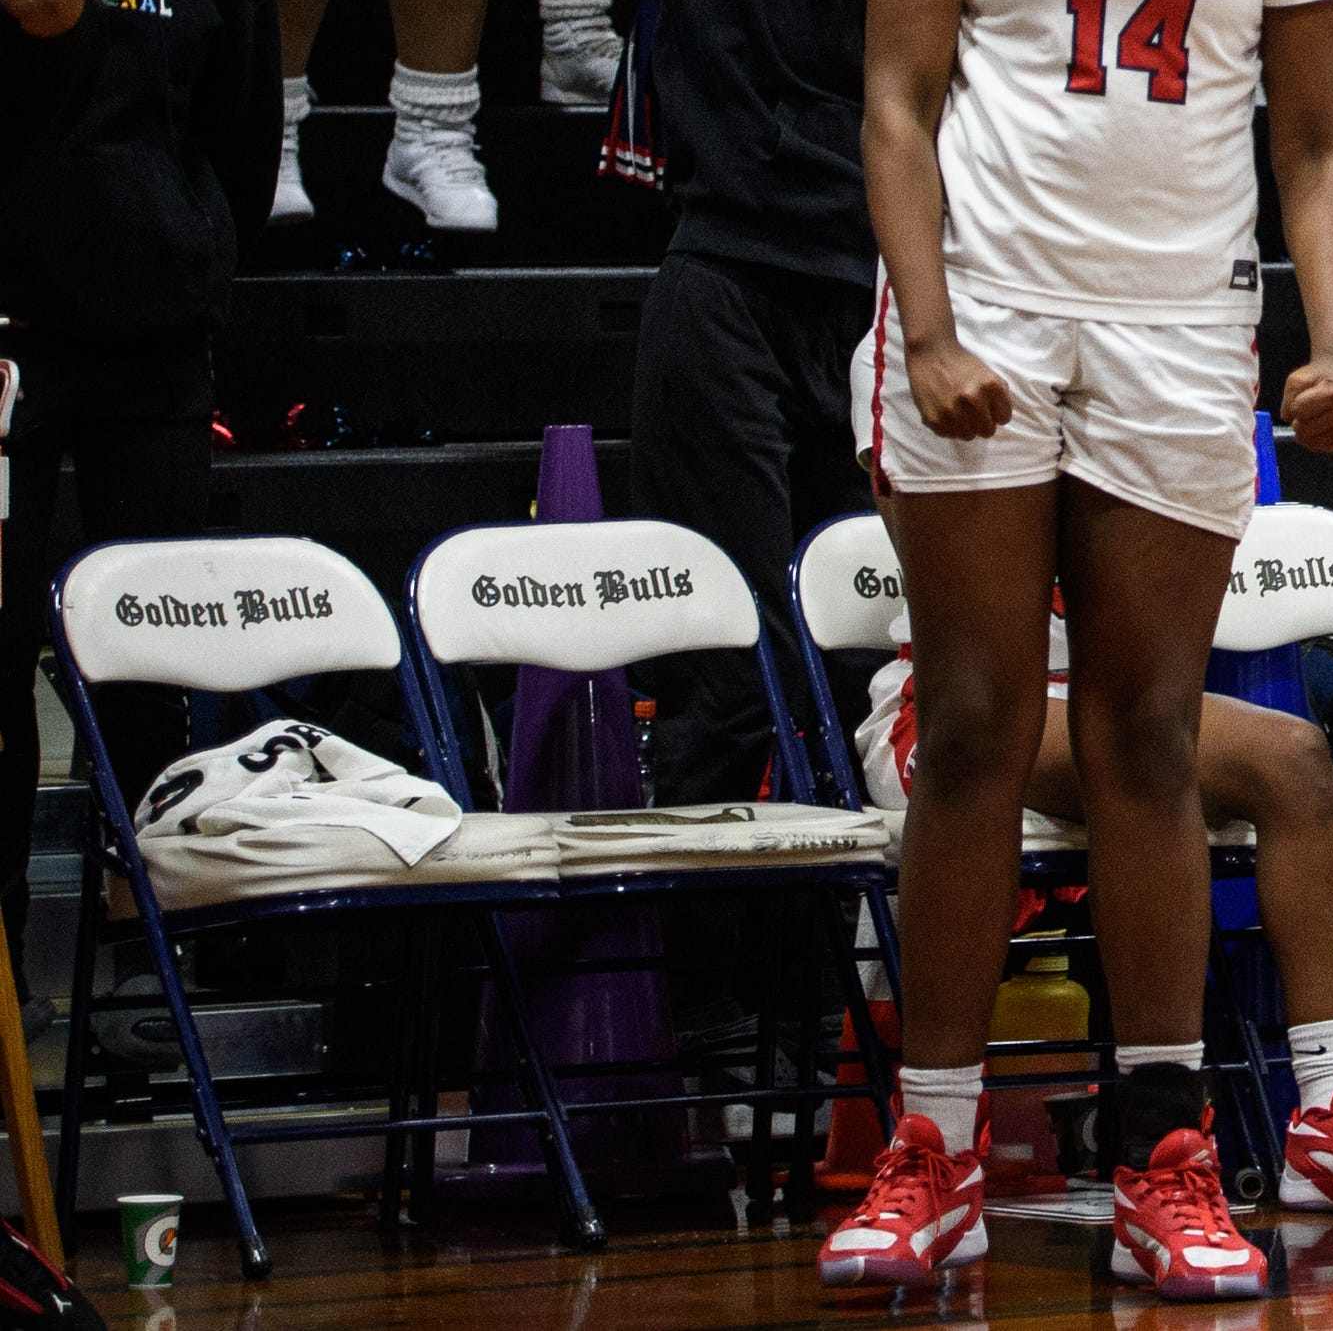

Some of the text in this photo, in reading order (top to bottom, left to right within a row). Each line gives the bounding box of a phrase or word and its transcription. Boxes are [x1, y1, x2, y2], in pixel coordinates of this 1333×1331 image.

[116, 587, 333, 629] Golden Bulls
[472, 567, 695, 609] Golden Bulls
